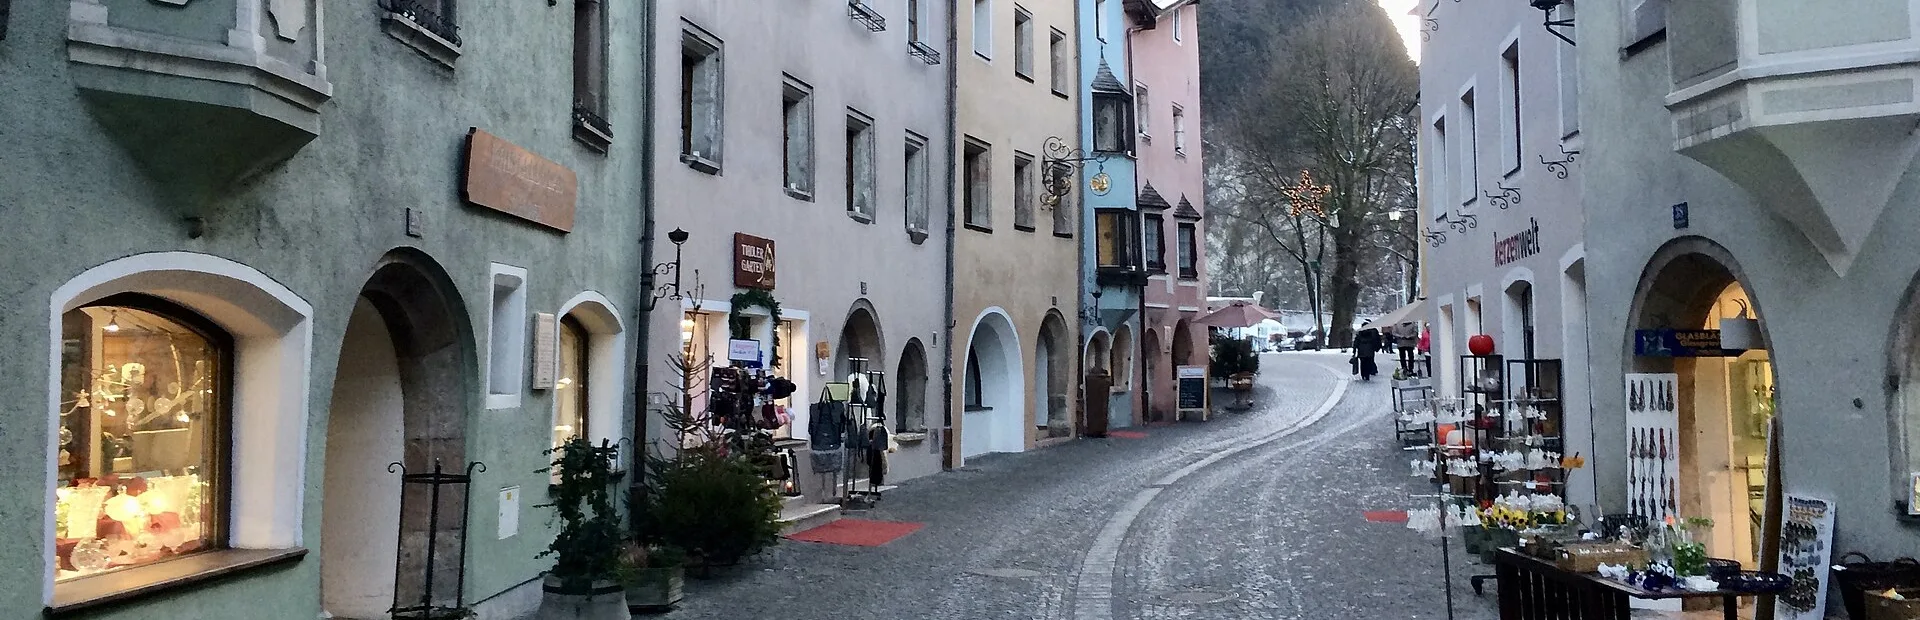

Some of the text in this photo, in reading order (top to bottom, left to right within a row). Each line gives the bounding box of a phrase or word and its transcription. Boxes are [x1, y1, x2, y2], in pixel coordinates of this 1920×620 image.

[1493, 217, 1541, 268] kerzenwelt
[741, 244, 764, 260] TIROLER
[741, 259, 764, 273] GARTEN
[1675, 331, 1721, 340] GLASBLÄ
